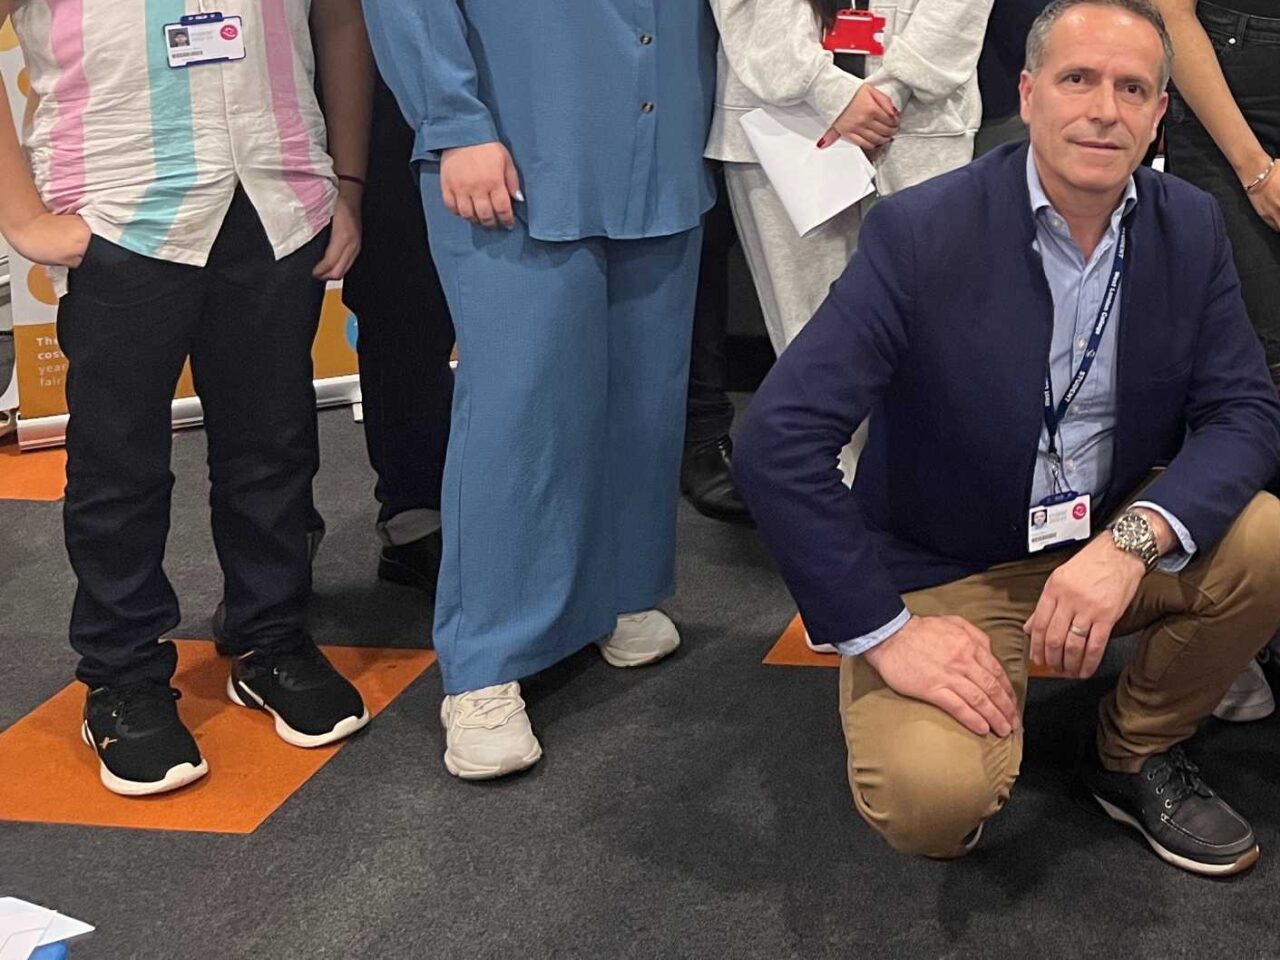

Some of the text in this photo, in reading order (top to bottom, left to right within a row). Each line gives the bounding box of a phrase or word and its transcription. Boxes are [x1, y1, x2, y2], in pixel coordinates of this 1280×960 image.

[1095, 271, 1121, 336] West London College
[1065, 370, 1086, 403] STUDENT
